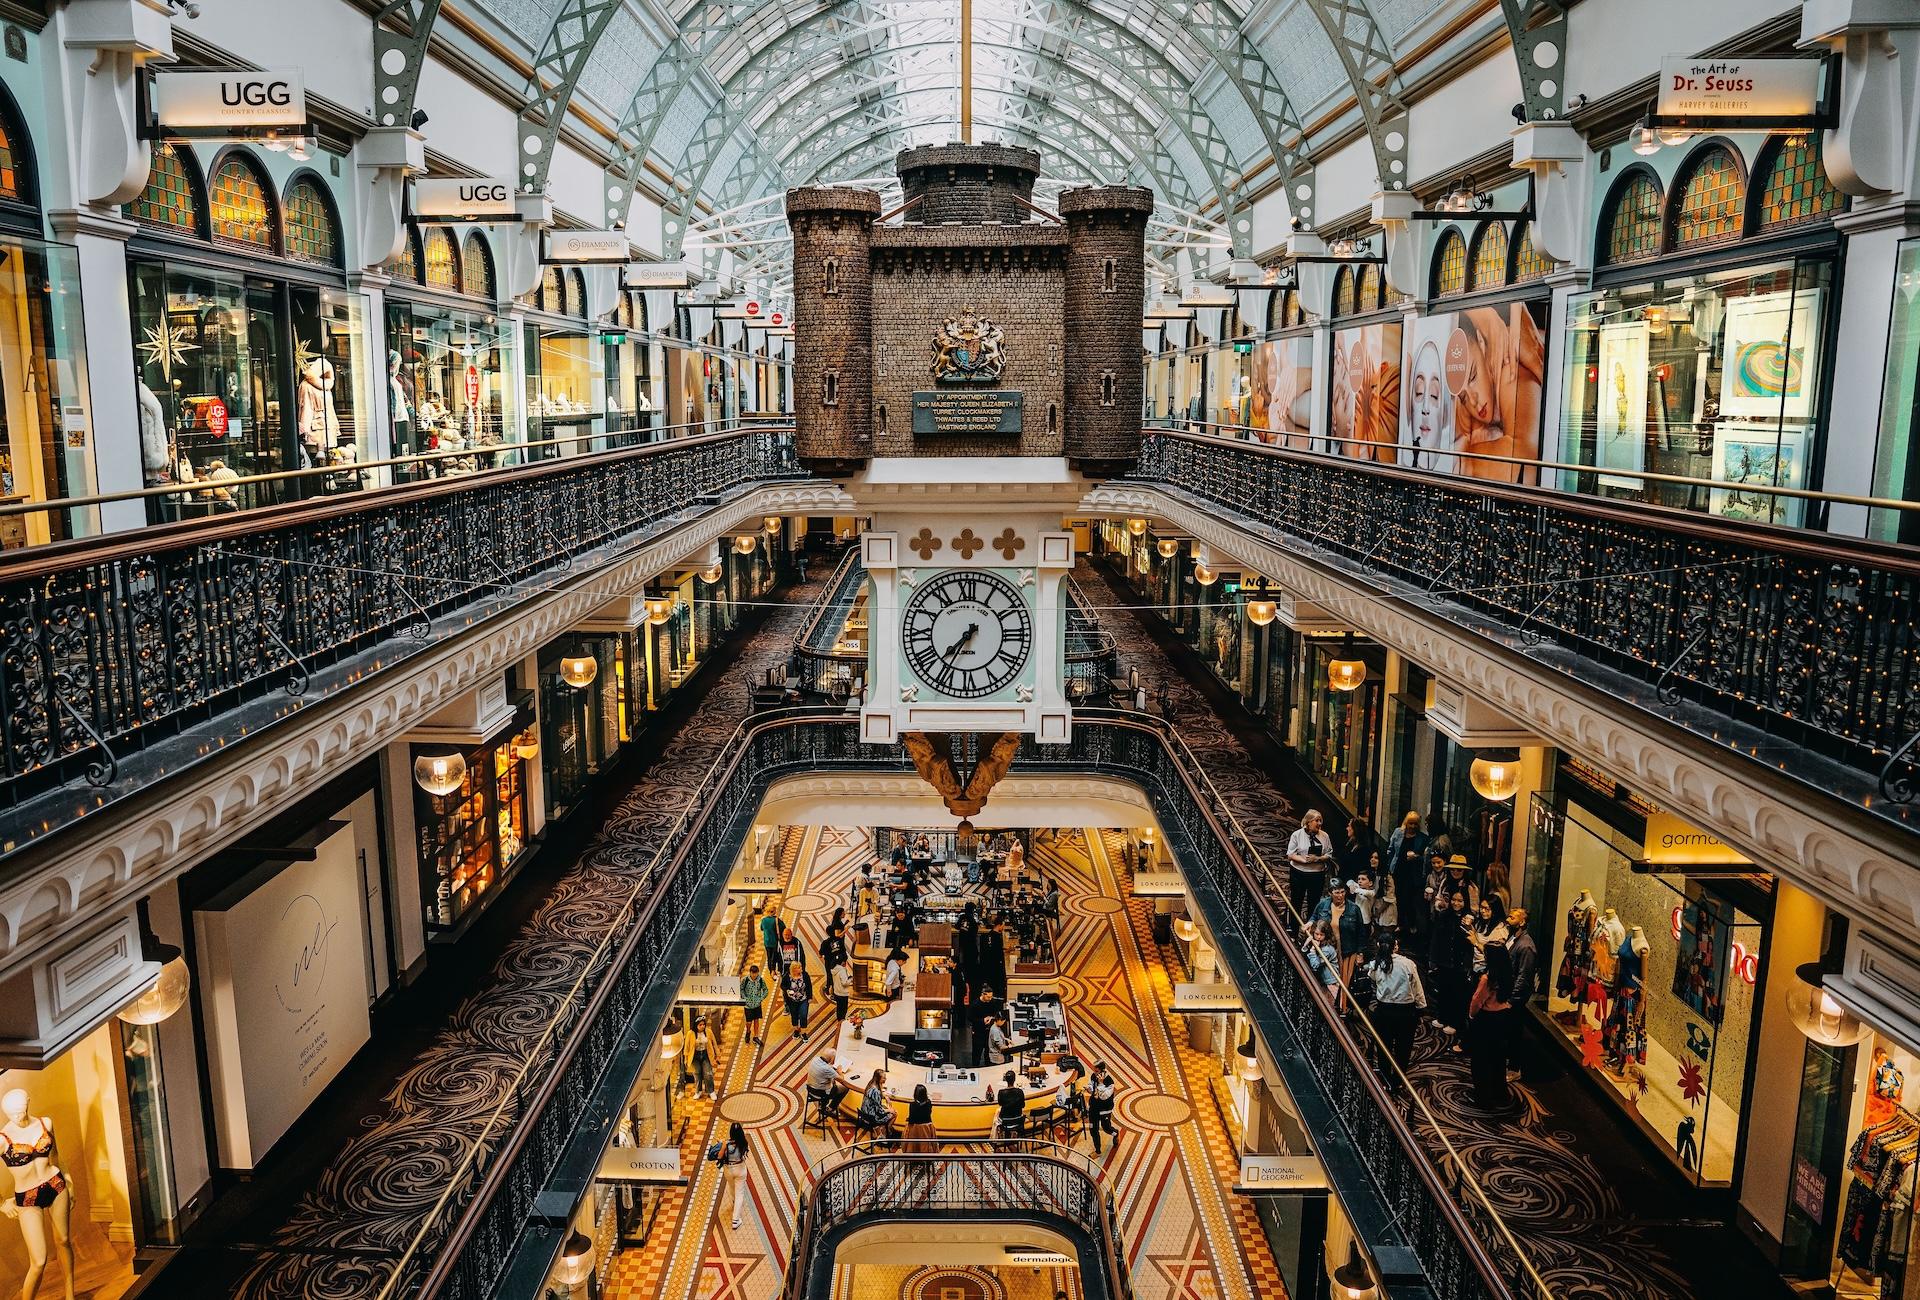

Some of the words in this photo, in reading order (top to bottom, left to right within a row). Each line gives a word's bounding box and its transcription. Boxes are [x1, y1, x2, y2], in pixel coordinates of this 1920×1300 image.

[1691, 66, 1706, 75] The
[1709, 63, 1727, 75] Art
[1730, 66, 1740, 75] of
[1673, 75, 1698, 91] Dr.
[1705, 75, 1753, 91] Seuss
[221, 82, 290, 106] UGG
[1679, 101, 1706, 109] HARVEY
[1709, 101, 1748, 109] GALLERIES
[257, 107, 291, 115] CLASSICS
[459, 185, 507, 201] UGG
[581, 240, 620, 248] DIAMONDS
[210, 405, 225, 417] UGG
[743, 876, 775, 884] BALLY
[691, 984, 736, 995] FURLA
[630, 1161, 675, 1170] OROTON
